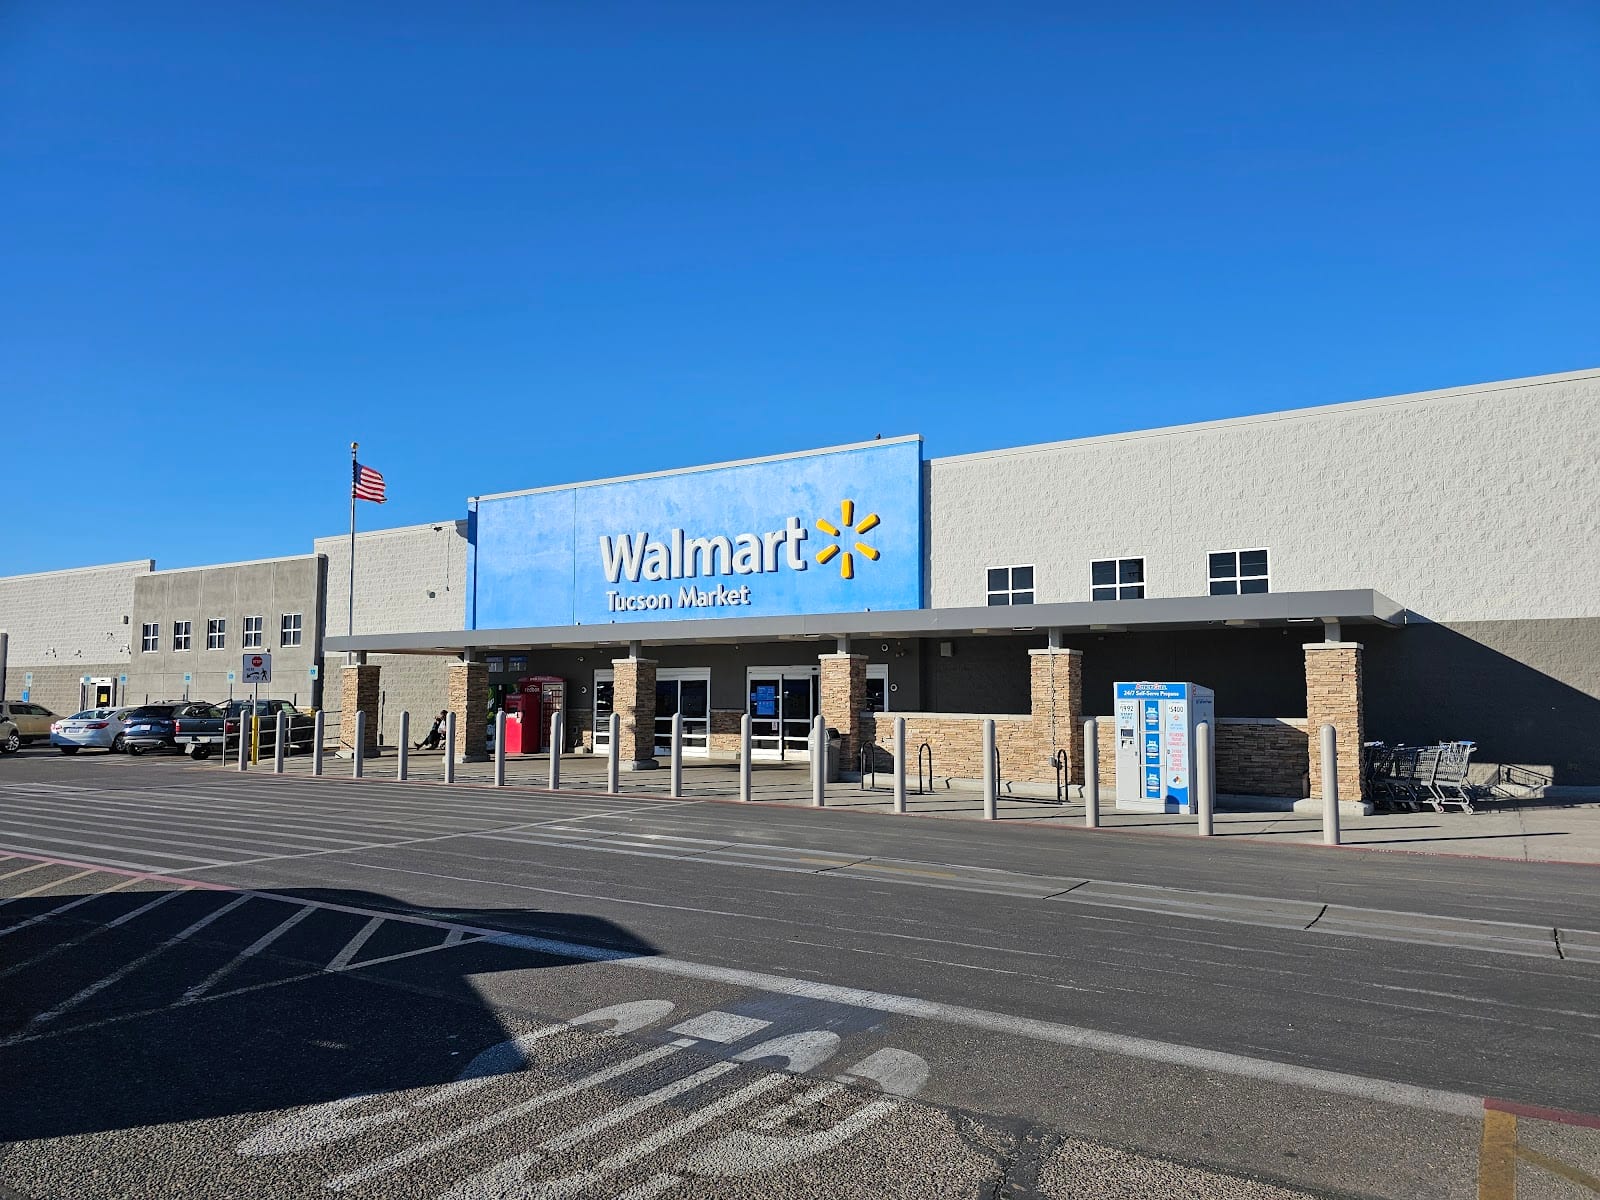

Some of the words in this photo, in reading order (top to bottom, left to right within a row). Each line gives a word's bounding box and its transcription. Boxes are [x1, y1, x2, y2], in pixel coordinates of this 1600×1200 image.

[599, 516, 808, 583] Walmart
[606, 590, 672, 612] Tucson
[678, 584, 752, 609] Market
